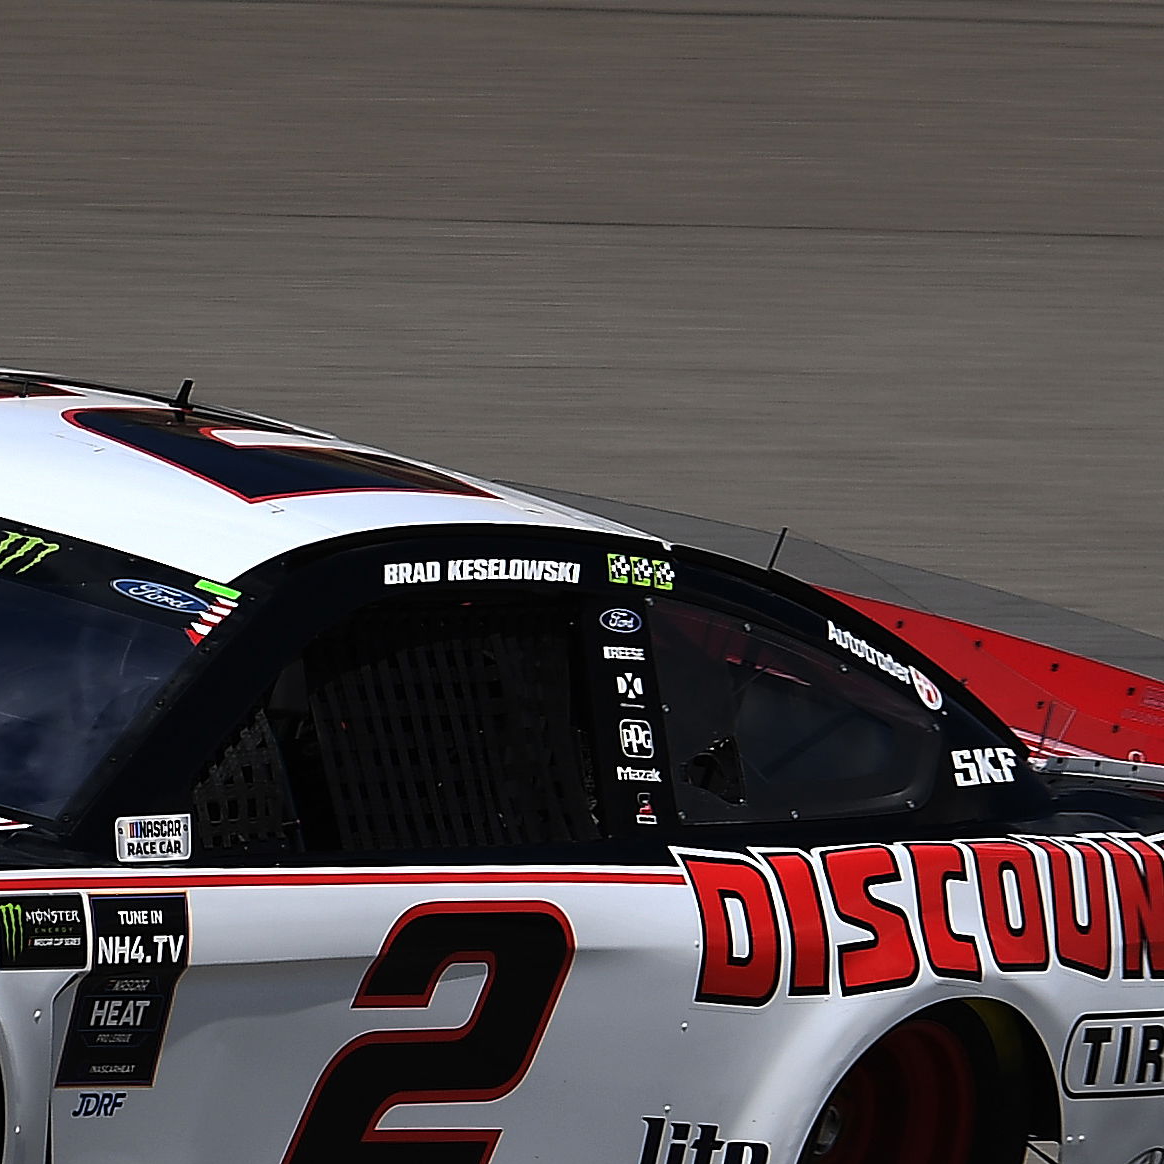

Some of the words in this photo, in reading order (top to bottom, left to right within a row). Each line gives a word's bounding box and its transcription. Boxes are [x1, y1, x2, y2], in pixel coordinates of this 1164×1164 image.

[384, 561, 441, 585] BRAD
[447, 559, 581, 584] KESELOWSKI
[128, 584, 195, 609] Ford
[622, 724, 653, 754] PPG
[616, 766, 663, 783] Mazak
[952, 747, 1016, 787] SKF
[138, 819, 182, 839] NASCAR
[127, 841, 157, 856] RACE
[158, 840, 182, 854] CAR
[117, 910, 149, 925] TUNE
[150, 910, 164, 925] IN
[97, 934, 185, 965] NH4.TV
[89, 1000, 151, 1026] HEAT
[1082, 1025, 1164, 1086] TIR
[71, 1091, 127, 1118] JDRF
